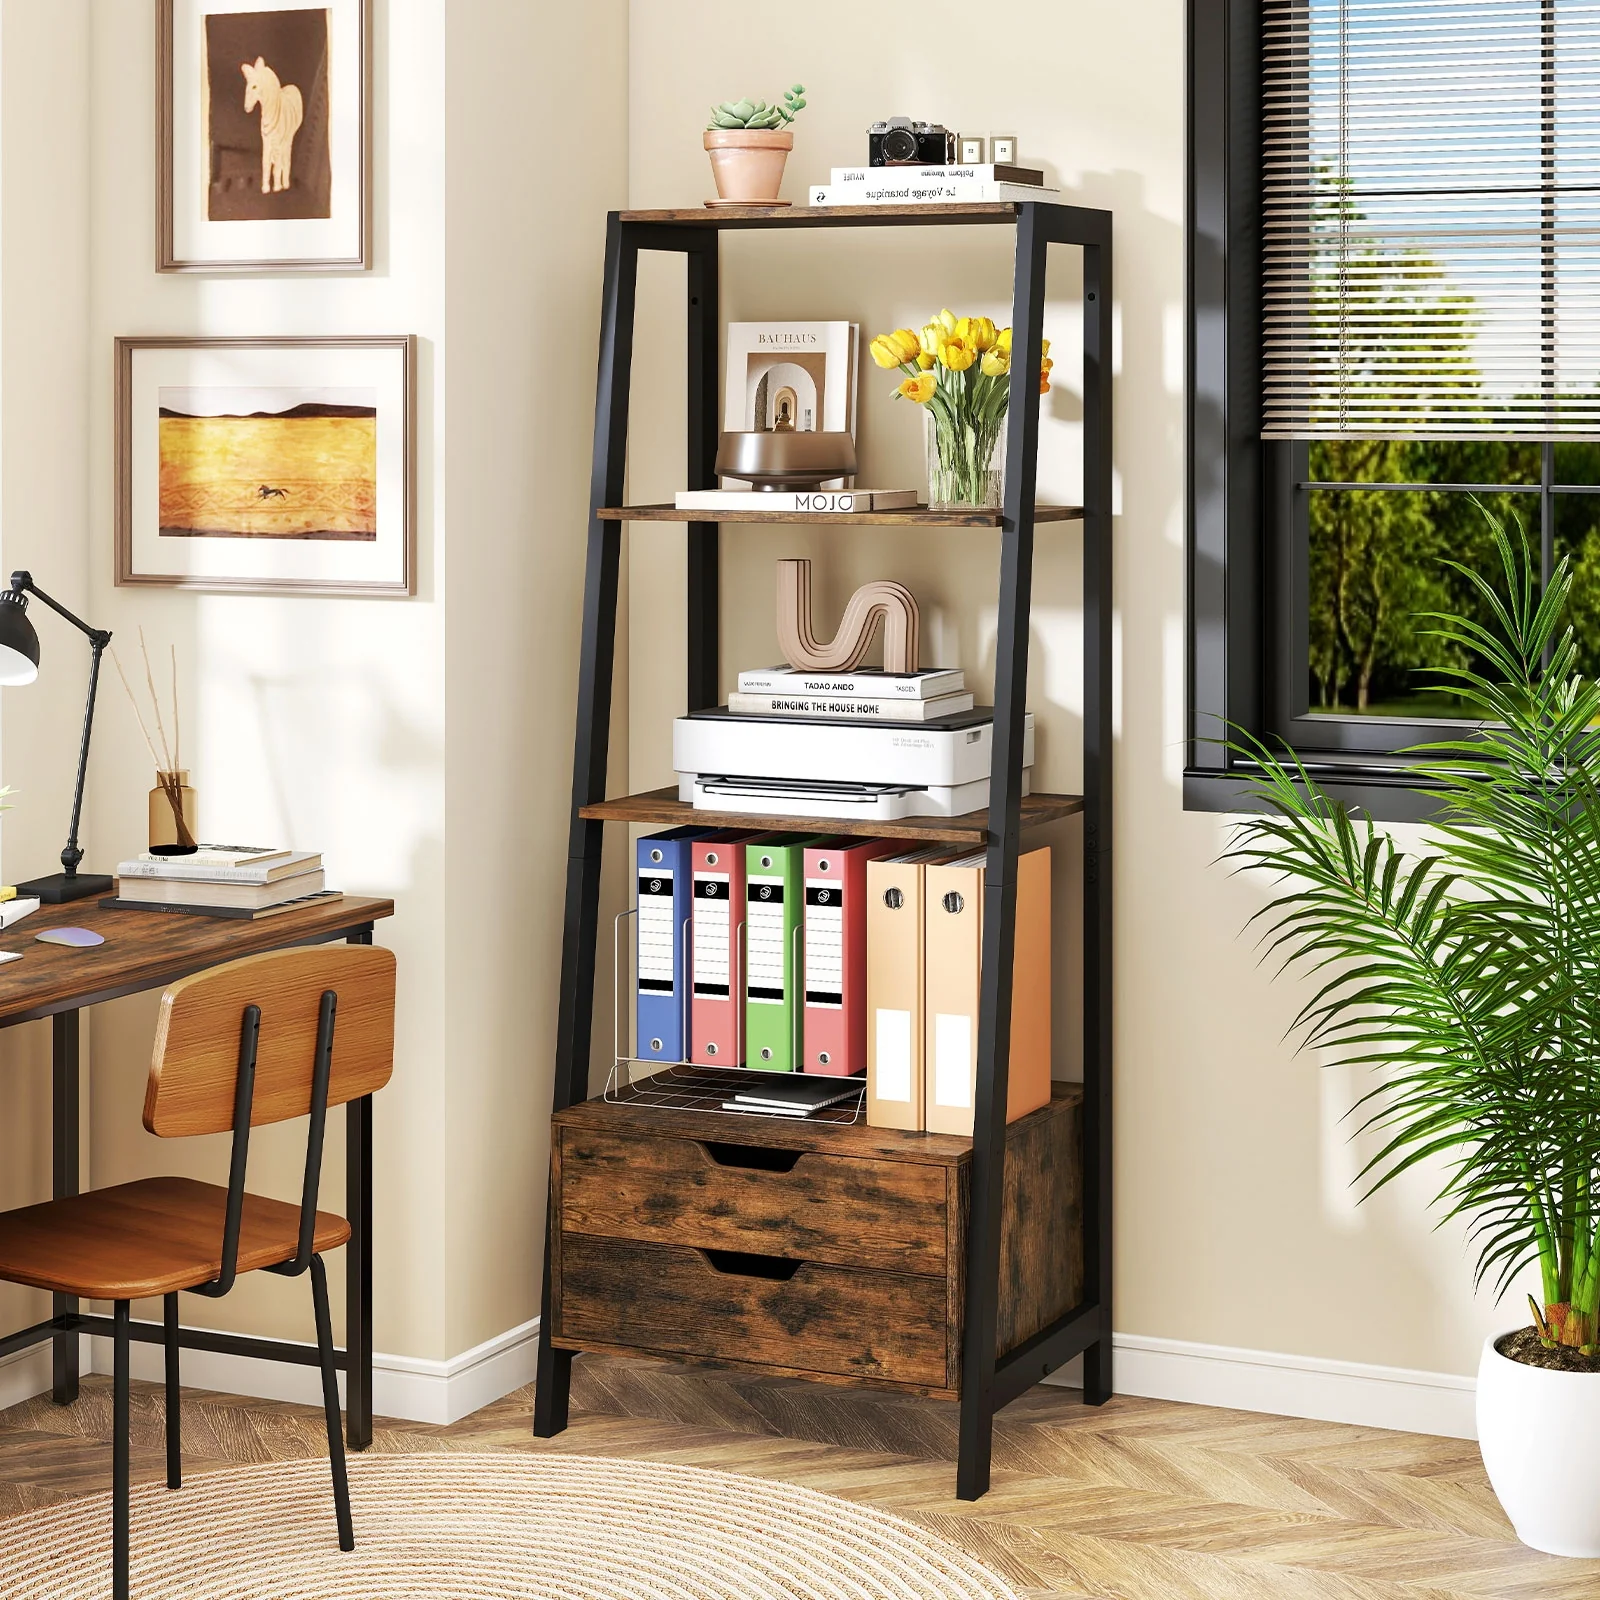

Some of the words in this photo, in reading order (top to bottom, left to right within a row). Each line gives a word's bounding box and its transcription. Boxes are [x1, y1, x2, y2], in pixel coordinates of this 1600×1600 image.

[758, 333, 817, 344] BAUHAUS
[795, 493, 853, 511] MOJO
[771, 700, 809, 711] BRINGING
[811, 701, 827, 712] THE
[828, 702, 855, 713] HOUSE
[856, 703, 880, 714] HOME
